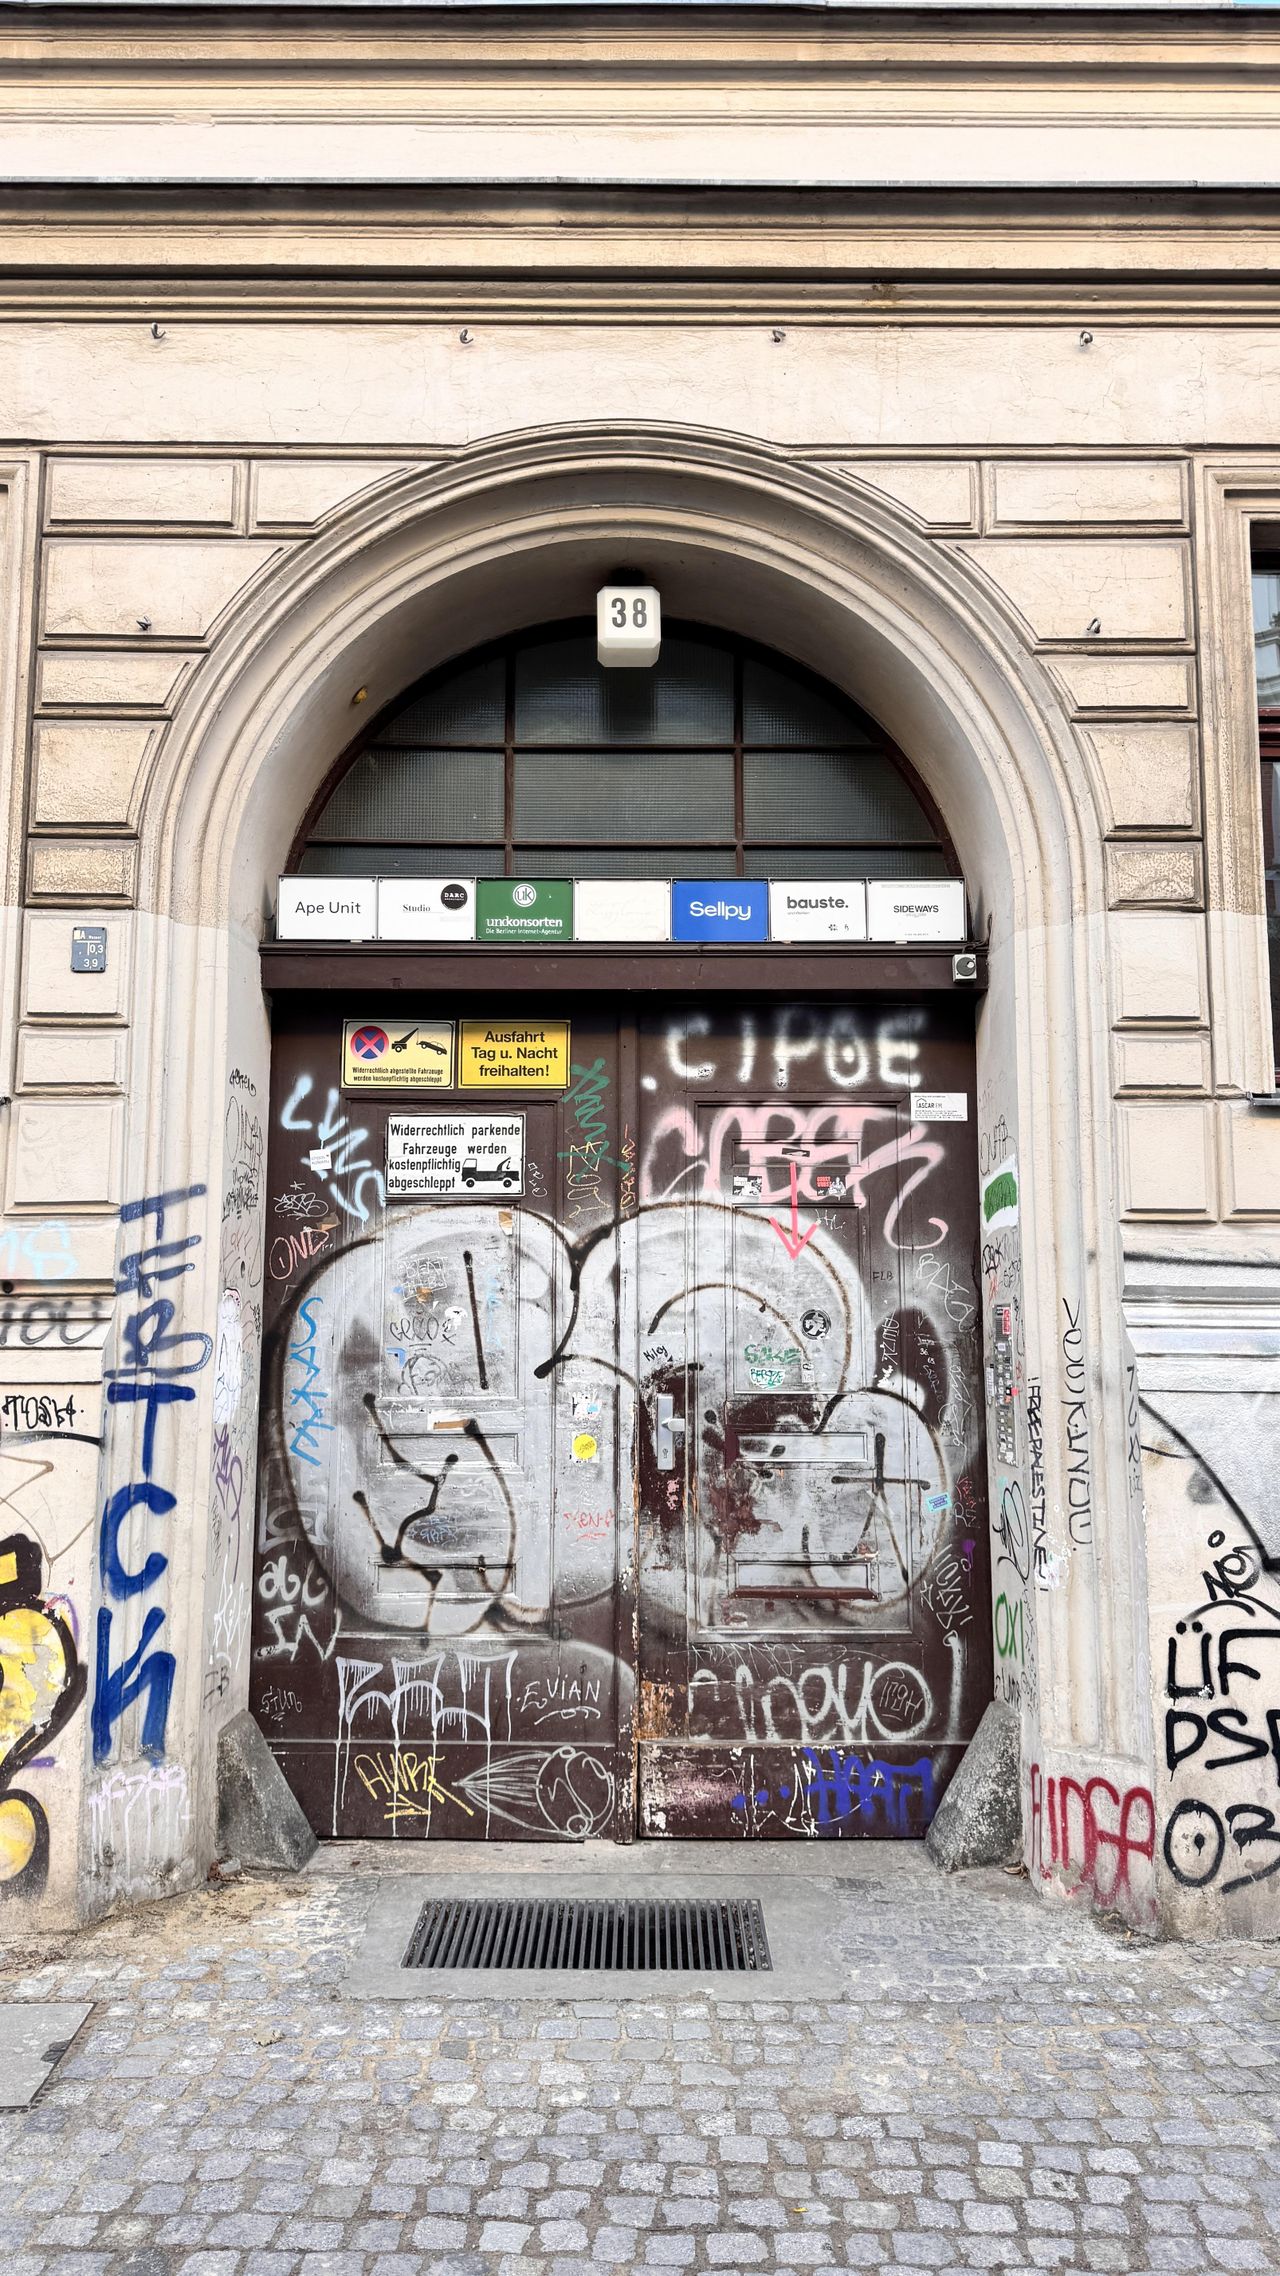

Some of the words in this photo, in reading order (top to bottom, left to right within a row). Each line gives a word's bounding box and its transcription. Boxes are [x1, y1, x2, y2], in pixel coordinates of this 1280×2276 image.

[611, 597, 647, 628] 38
[295, 901, 325, 917] Ape
[328, 901, 361, 915] Unit
[402, 904, 431, 912] Studio
[787, 896, 849, 909] bauste.
[893, 905, 939, 913] SIDEWAYS
[690, 901, 751, 921] Sellpy
[486, 916, 563, 927] undkonsorten
[518, 928, 563, 936] Internet-Agentur
[484, 1030, 546, 1043] Ausfahrt
[471, 1047, 496, 1062] Tag
[500, 1049, 512, 1059] u.
[516, 1047, 558, 1059] Nacht
[389, 1067, 417, 1075] abgestellte
[479, 1065, 550, 1077] freihalten!
[373, 1075, 409, 1083] kostenpflichtig
[390, 1123, 465, 1136] Widerrechtlich
[471, 1124, 521, 1139] parkende
[402, 1143, 457, 1157] Fahrzeuge
[467, 1143, 507, 1155] werden
[389, 1158, 461, 1172] kostenpflichtig
[389, 1176, 456, 1191] abgeschleppt
